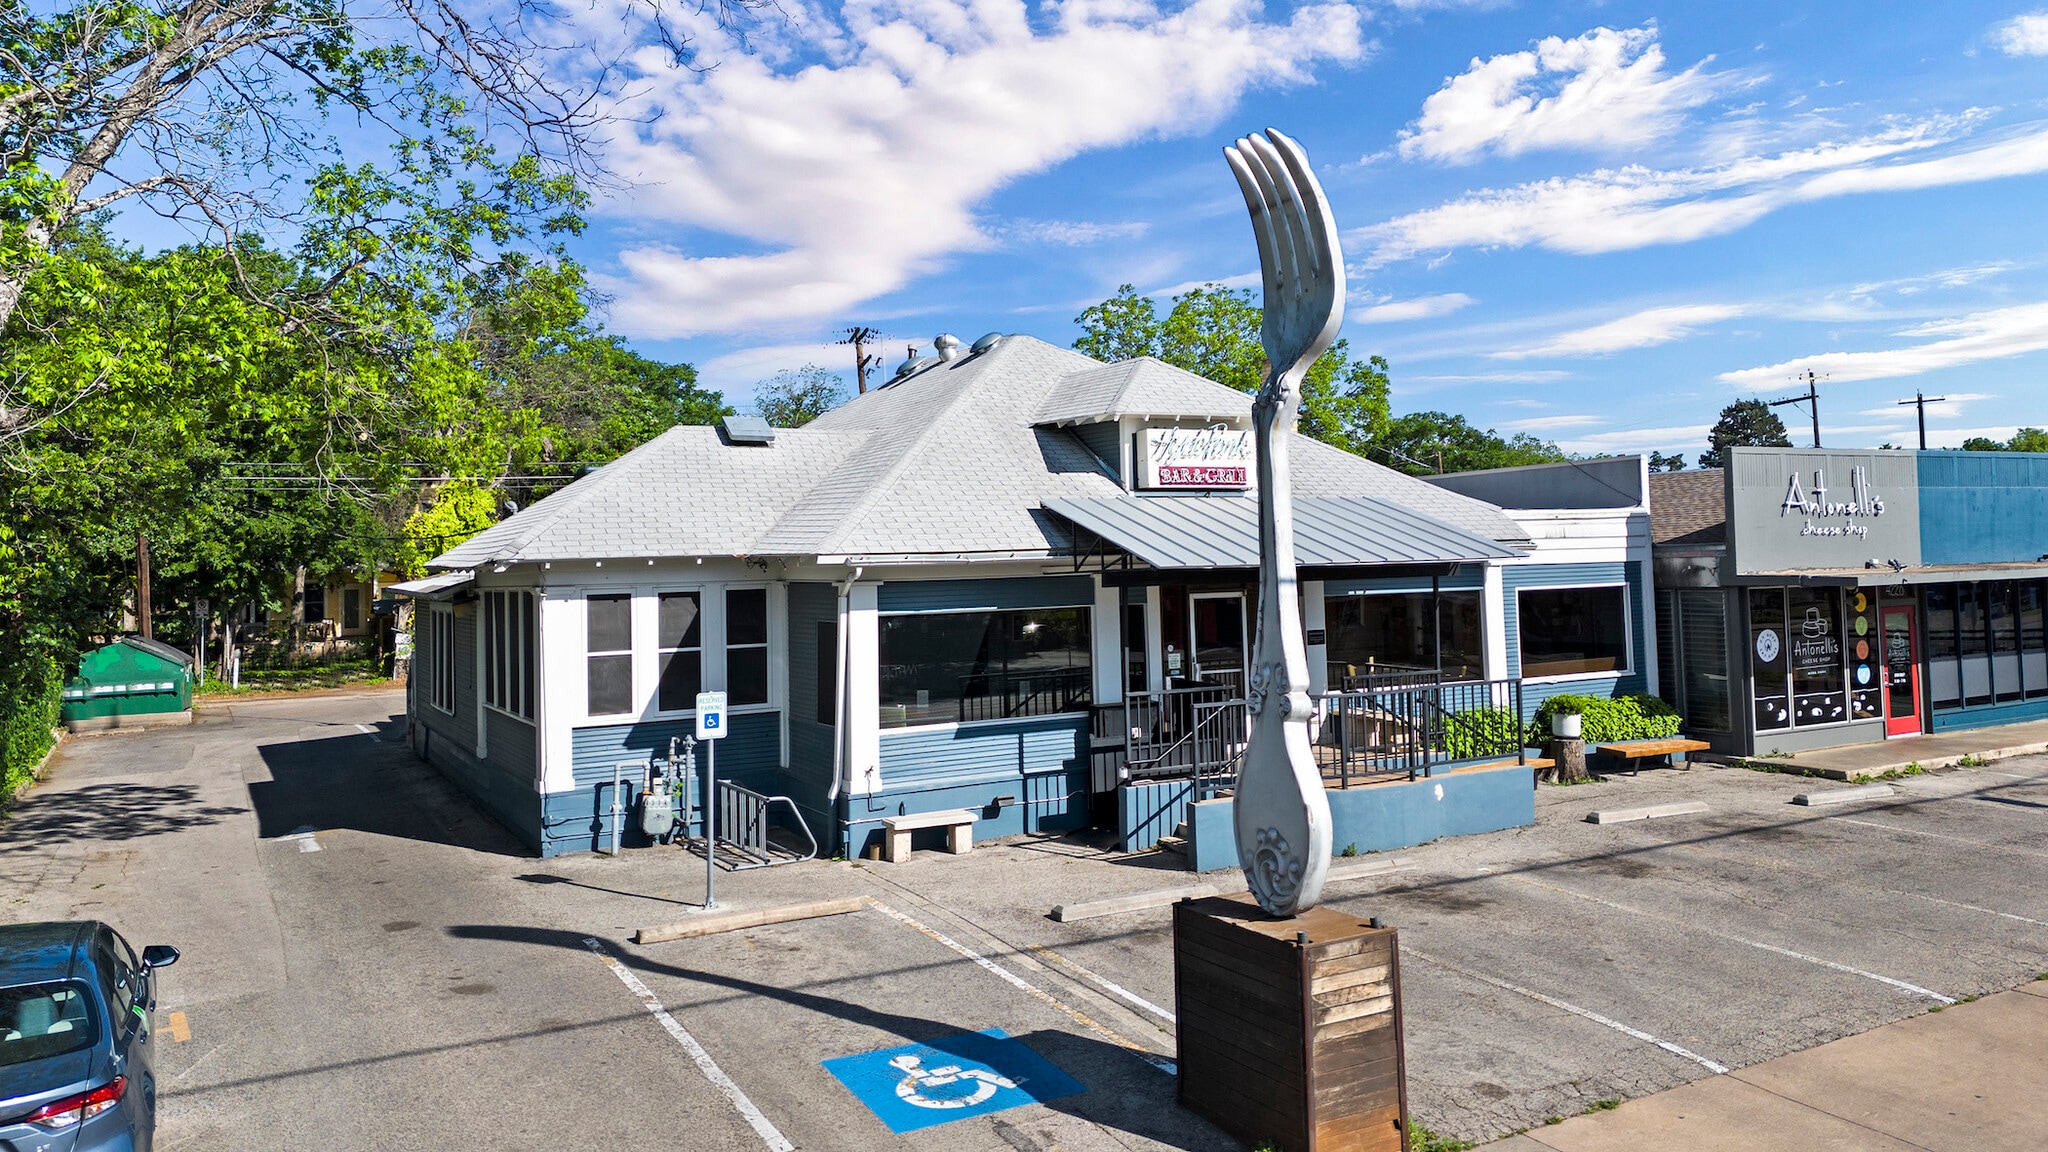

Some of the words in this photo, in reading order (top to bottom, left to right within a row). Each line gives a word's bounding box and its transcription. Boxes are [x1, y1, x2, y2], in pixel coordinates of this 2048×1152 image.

[1160, 467, 1191, 484] BAR
[1192, 467, 1206, 484] &
[1783, 465, 1885, 518] Antonelli's
[1803, 518, 1841, 536] cheese
[1844, 518, 1869, 540] shop
[1793, 637, 1839, 657] Antonelli's
[698, 695, 725, 704] RESERVED
[700, 704, 723, 712] PARKING
